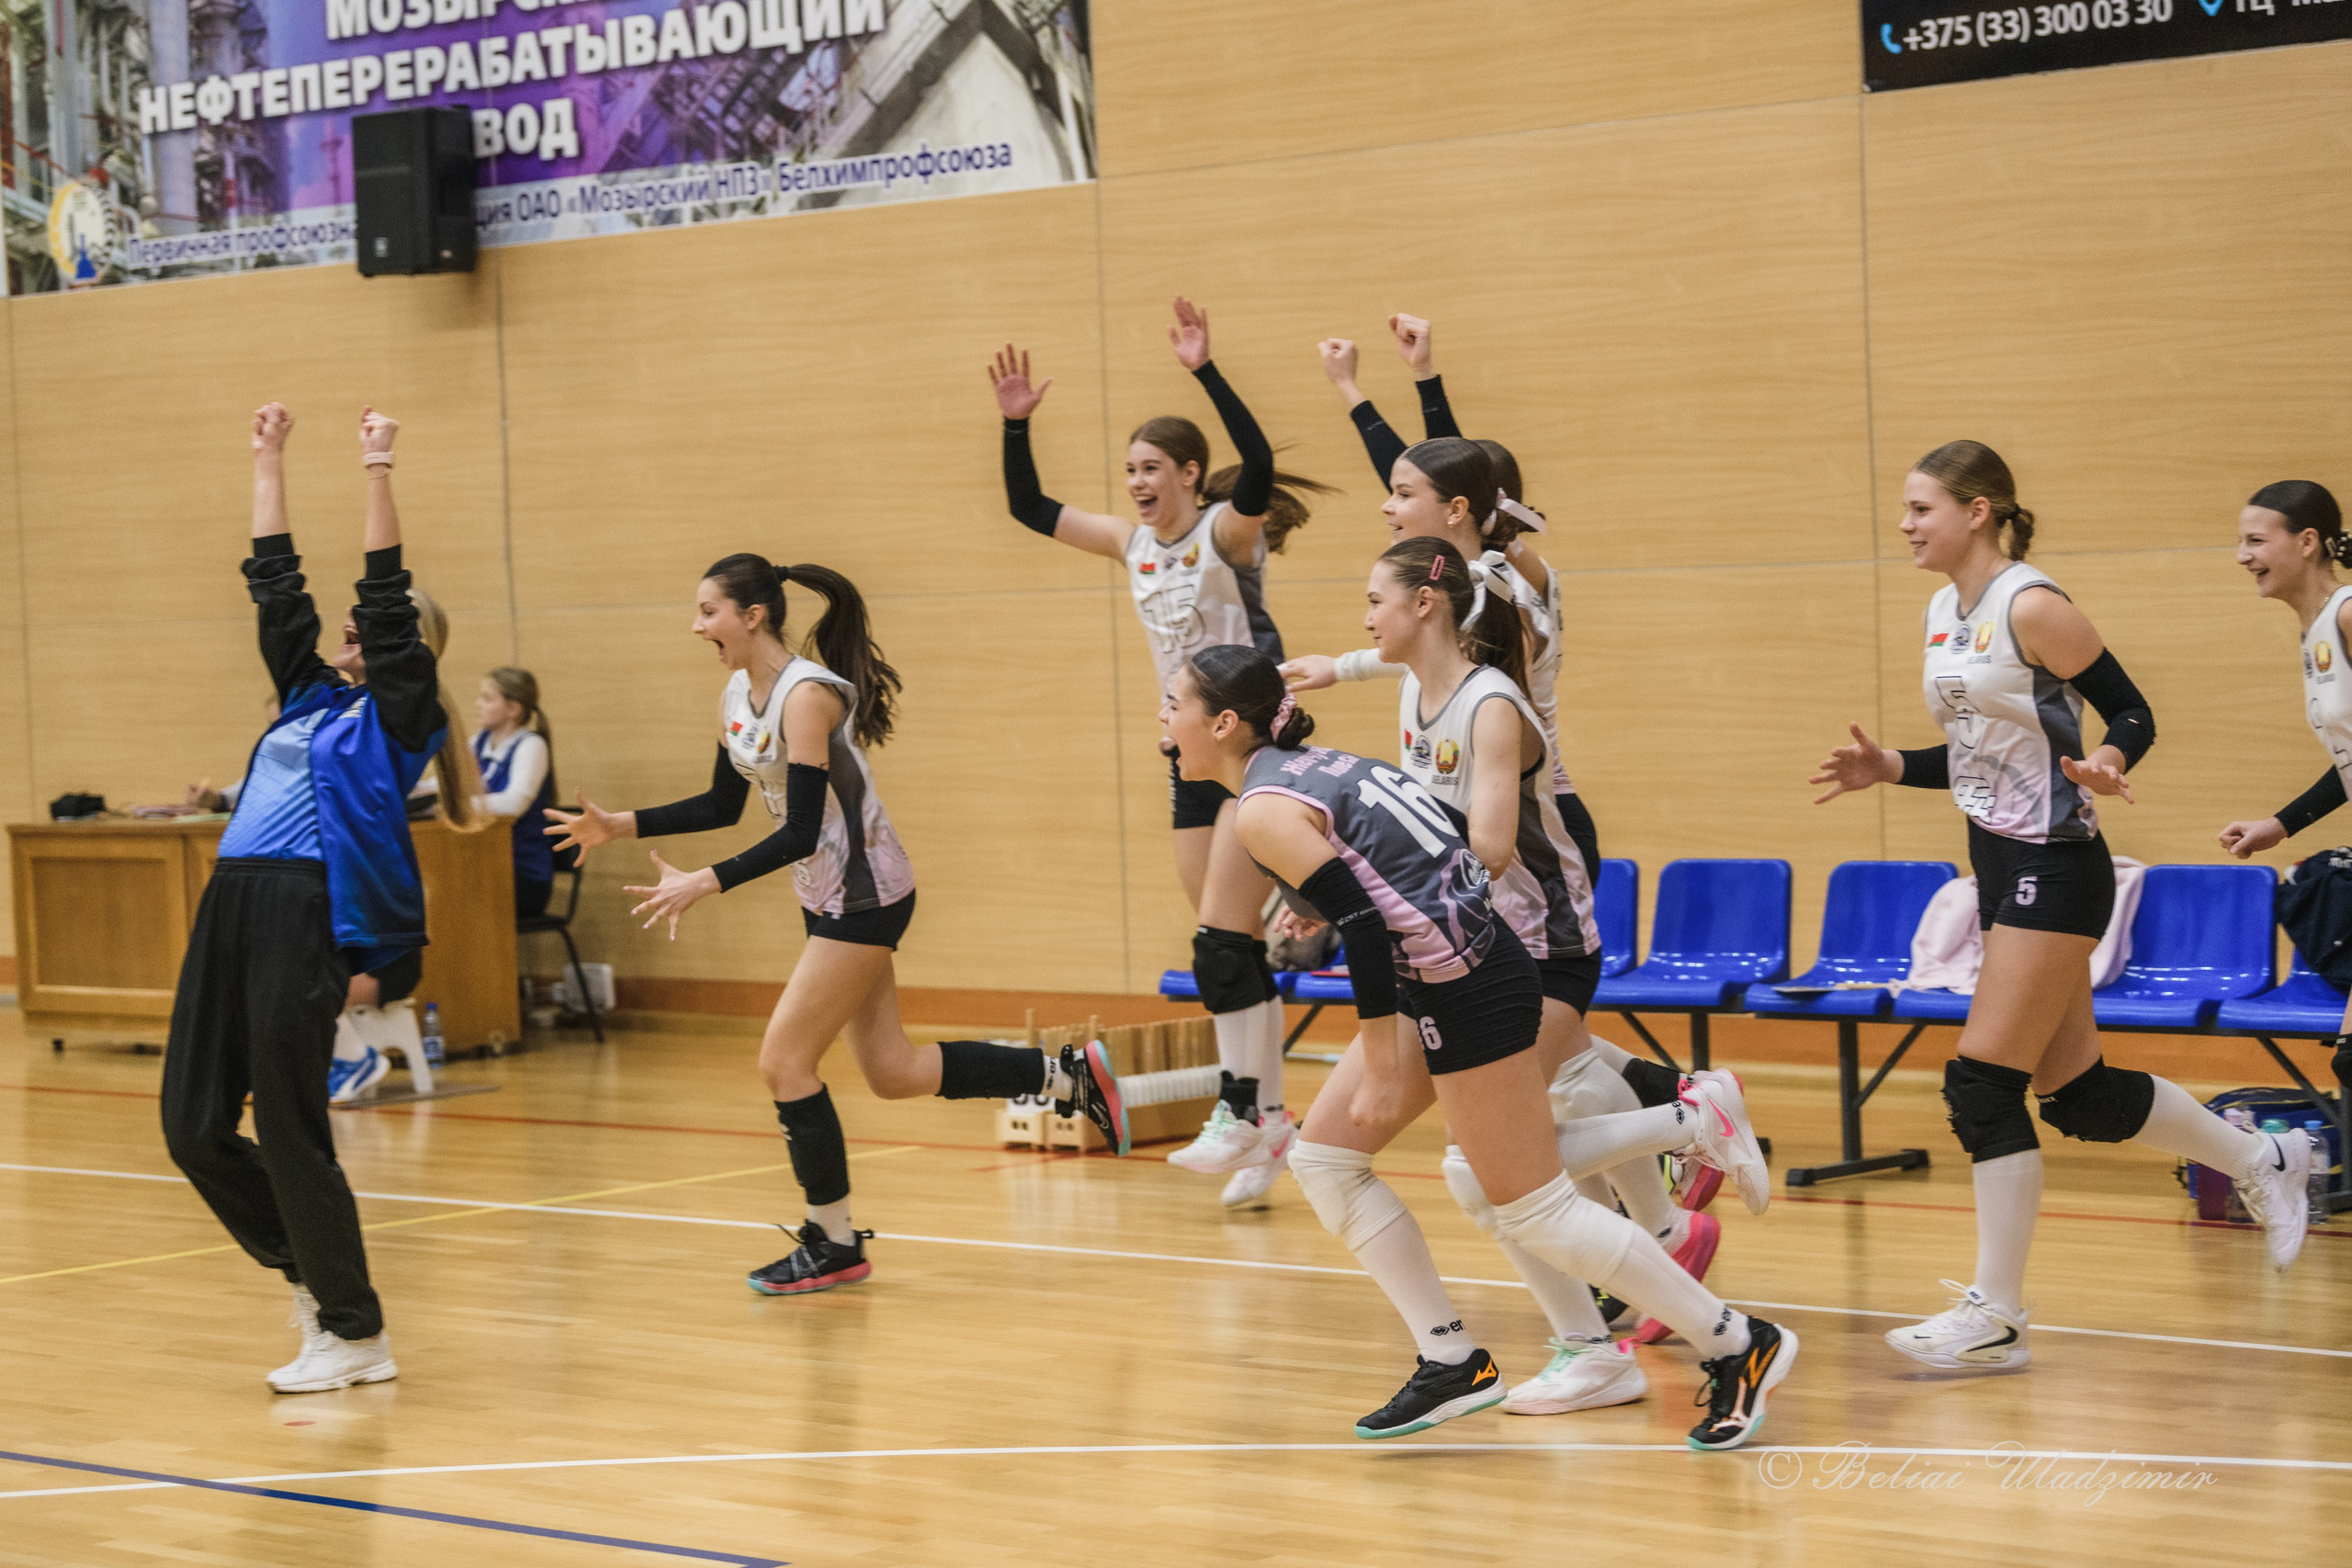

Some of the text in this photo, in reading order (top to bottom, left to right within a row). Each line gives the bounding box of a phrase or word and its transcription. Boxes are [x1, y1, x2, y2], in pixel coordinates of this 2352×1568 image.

[1903, 0, 2174, 51] +375 (33) 300 03 30
[139, 0, 885, 135] НЕФТЕПЕРЕРАБАТЫВАЮЩИЙ
[472, 98, 579, 161] ВОД
[517, 190, 562, 221] ОАО
[778, 143, 1013, 191] Белхимпрофсоюза
[235, 220, 356, 261] профсоюзн
[1140, 584, 1207, 655] 15
[1356, 765, 1461, 859] 16
[2015, 875, 2038, 906] 5
